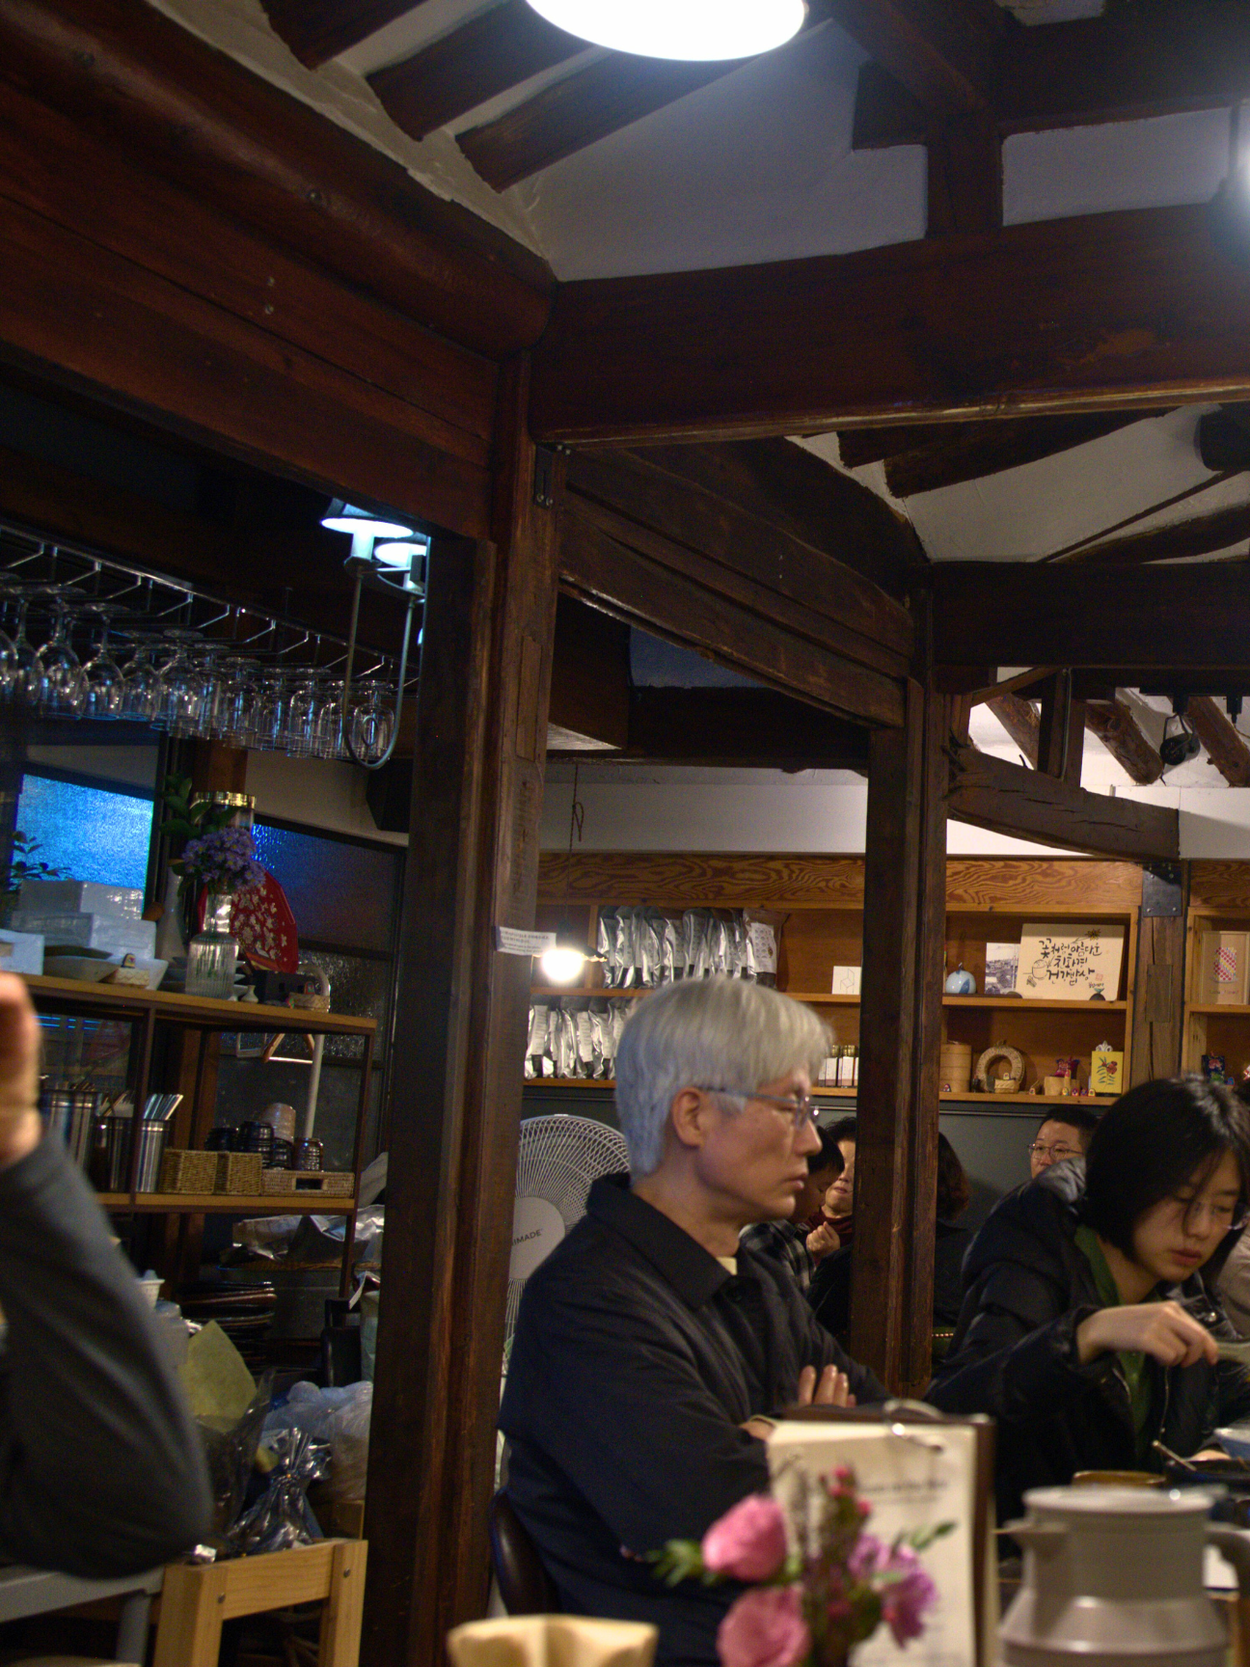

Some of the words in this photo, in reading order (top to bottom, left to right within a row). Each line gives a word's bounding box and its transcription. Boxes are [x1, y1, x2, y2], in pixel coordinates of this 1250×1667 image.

[1039, 938, 1070, 959] 꽃처럼
[1070, 942, 1102, 956] 아름다운
[1054, 953, 1087, 969] 친환경
[1046, 967, 1095, 986] 건강밥상
[511, 1228, 542, 1246] IMADE
